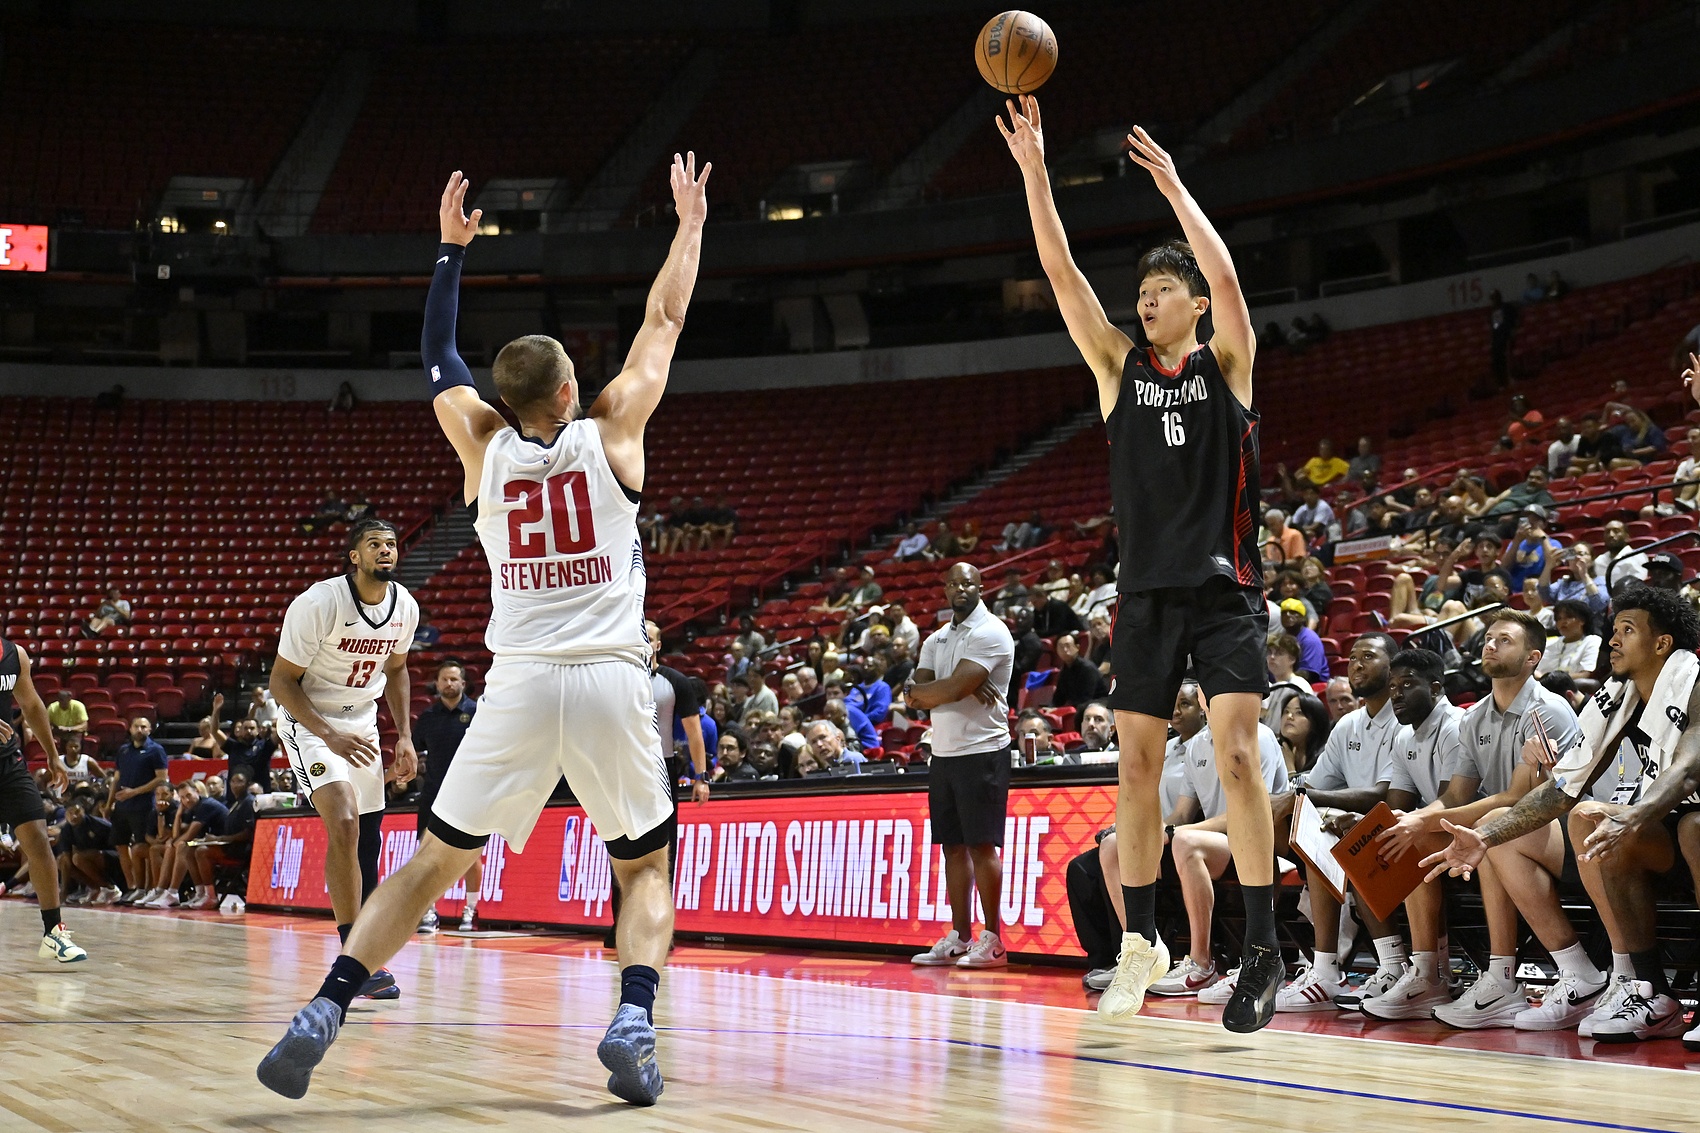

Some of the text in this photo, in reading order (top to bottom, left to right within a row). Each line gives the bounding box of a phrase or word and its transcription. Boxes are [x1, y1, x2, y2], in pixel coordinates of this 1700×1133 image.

[1447, 277, 1483, 305] 115
[259, 375, 296, 398] 113
[1134, 375, 1208, 408] PORTLAND
[1161, 412, 1186, 447] 16
[503, 471, 597, 559] 20
[500, 556, 613, 590] STEVENSON
[337, 637, 399, 655] NUGGETS
[346, 660, 377, 688] 13
[1348, 823, 1384, 857] Wilson
[279, 826, 304, 900] App
[573, 817, 612, 918] App
[713, 821, 778, 915] INTO
[780, 819, 913, 920] SUMMER
[917, 816, 1050, 926] LEUE
